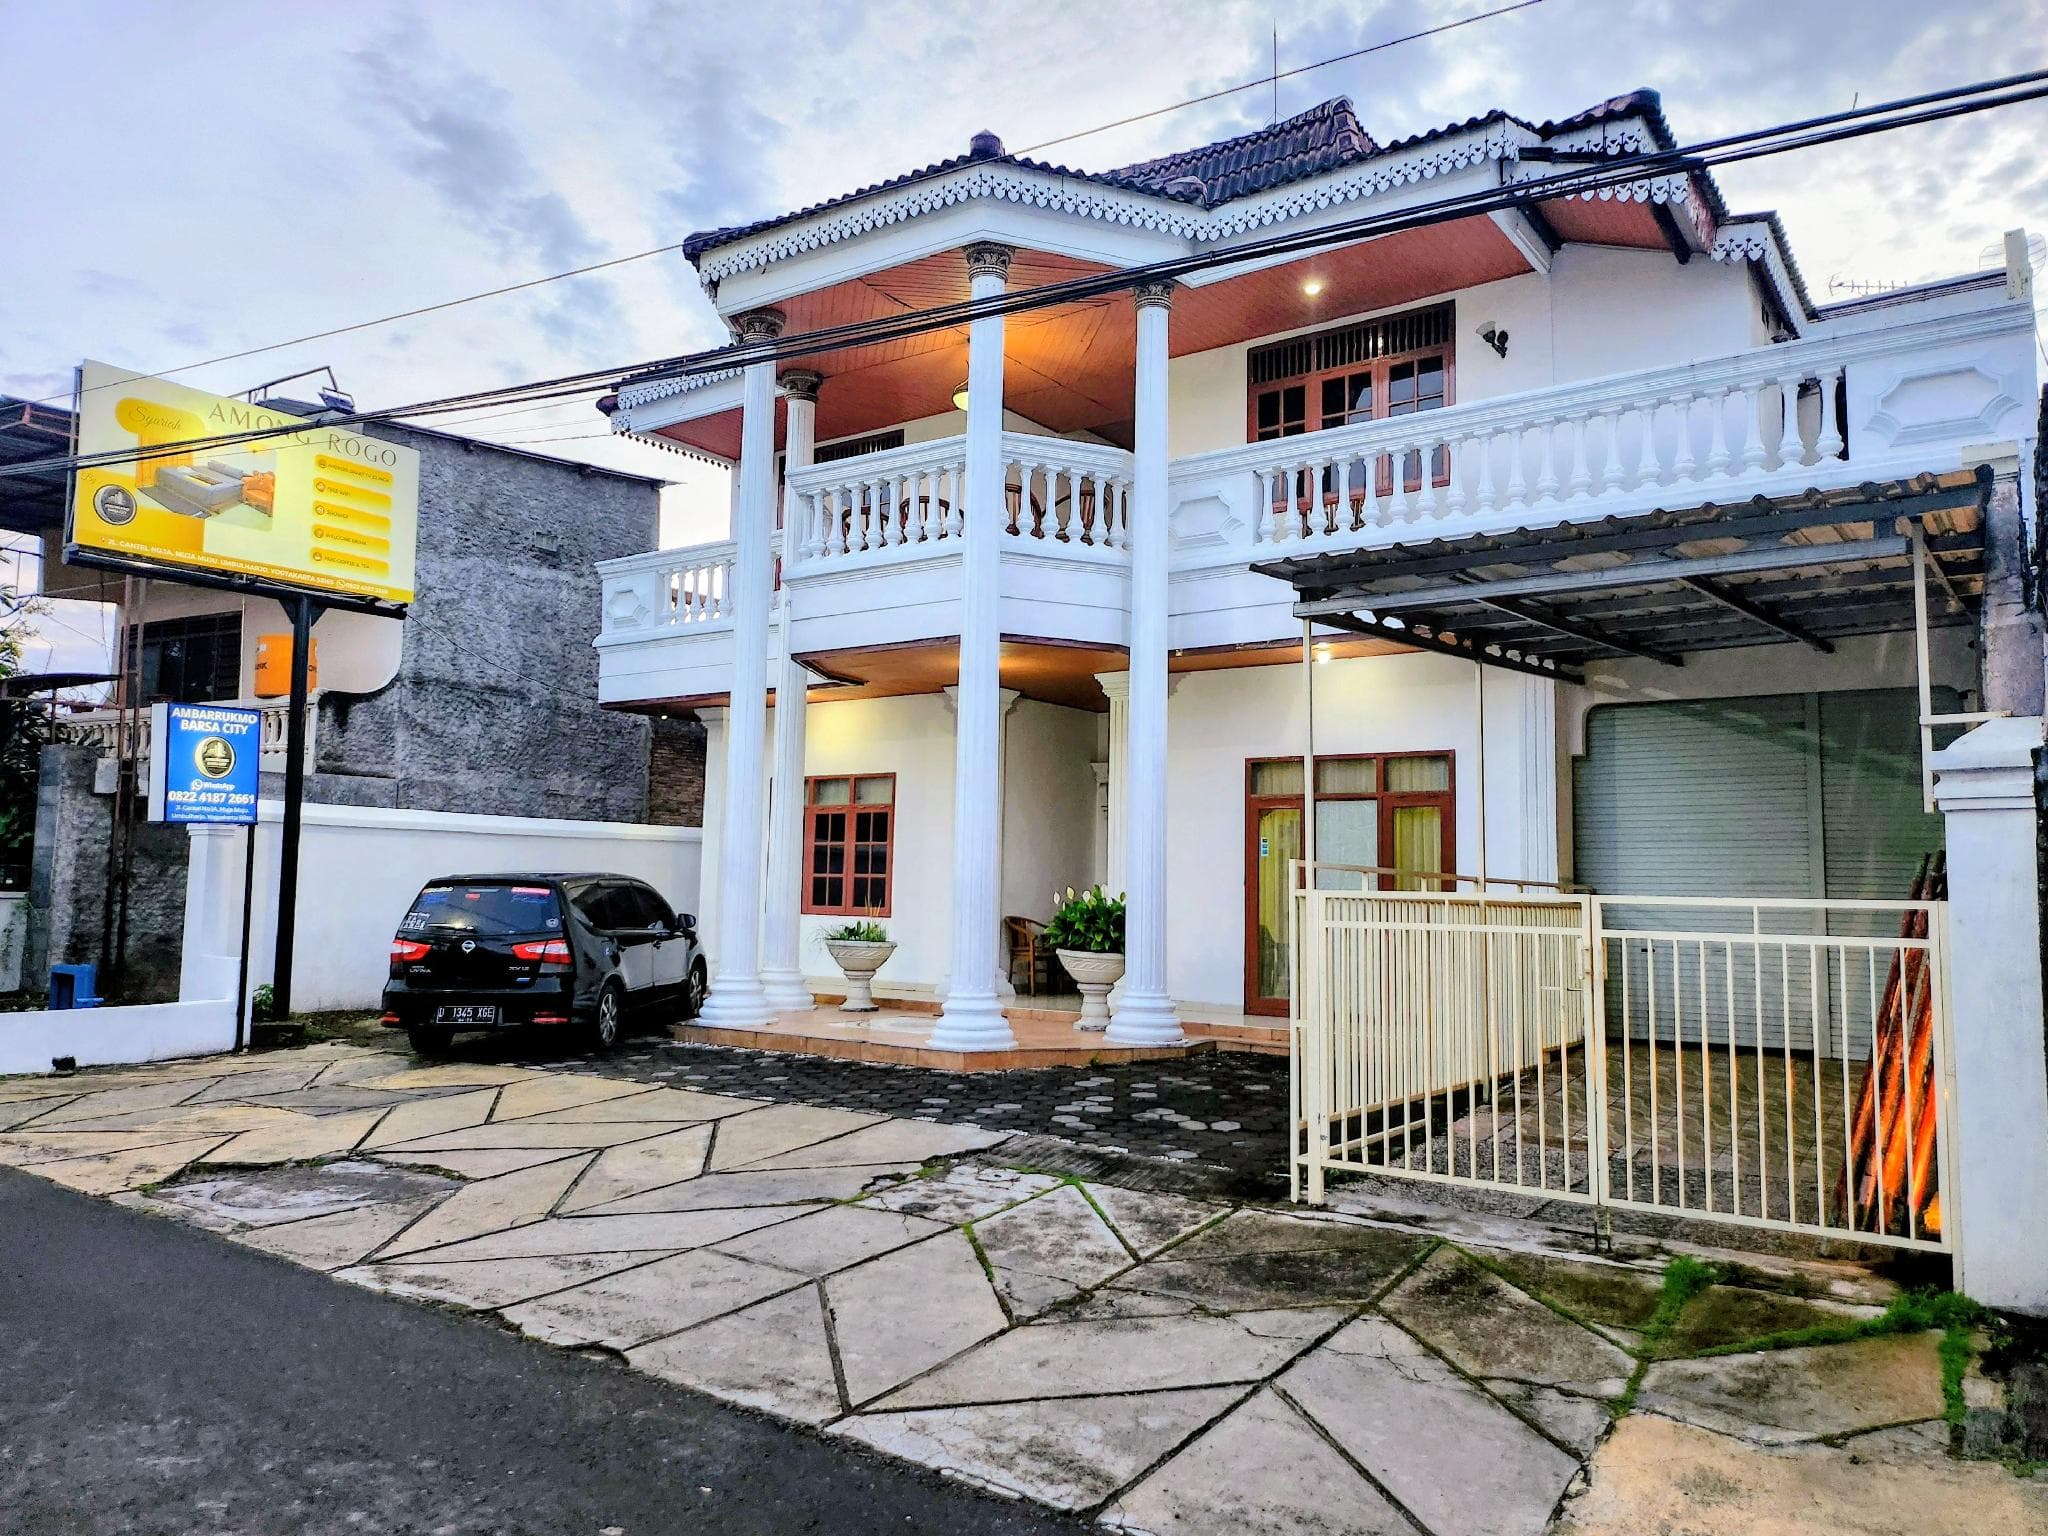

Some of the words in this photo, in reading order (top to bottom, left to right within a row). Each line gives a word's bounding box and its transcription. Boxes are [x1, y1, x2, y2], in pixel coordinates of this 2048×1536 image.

[129, 406, 183, 431] Syariah
[329, 433, 397, 467] ROGO
[119, 540, 148, 552] CANTEL
[271, 568, 316, 582] YOGYAKARTA
[171, 707, 258, 724] AMBARRUKMO
[180, 719, 221, 733] BARSA
[222, 722, 249, 735] CITY
[203, 782, 236, 791] WhatsApp
[168, 790, 197, 801] 0822
[198, 791, 227, 803] 4187
[228, 793, 255, 804] 2661
[438, 1007, 445, 1018] D
[453, 1007, 474, 1018] 1345
[477, 1007, 494, 1018] XGE
